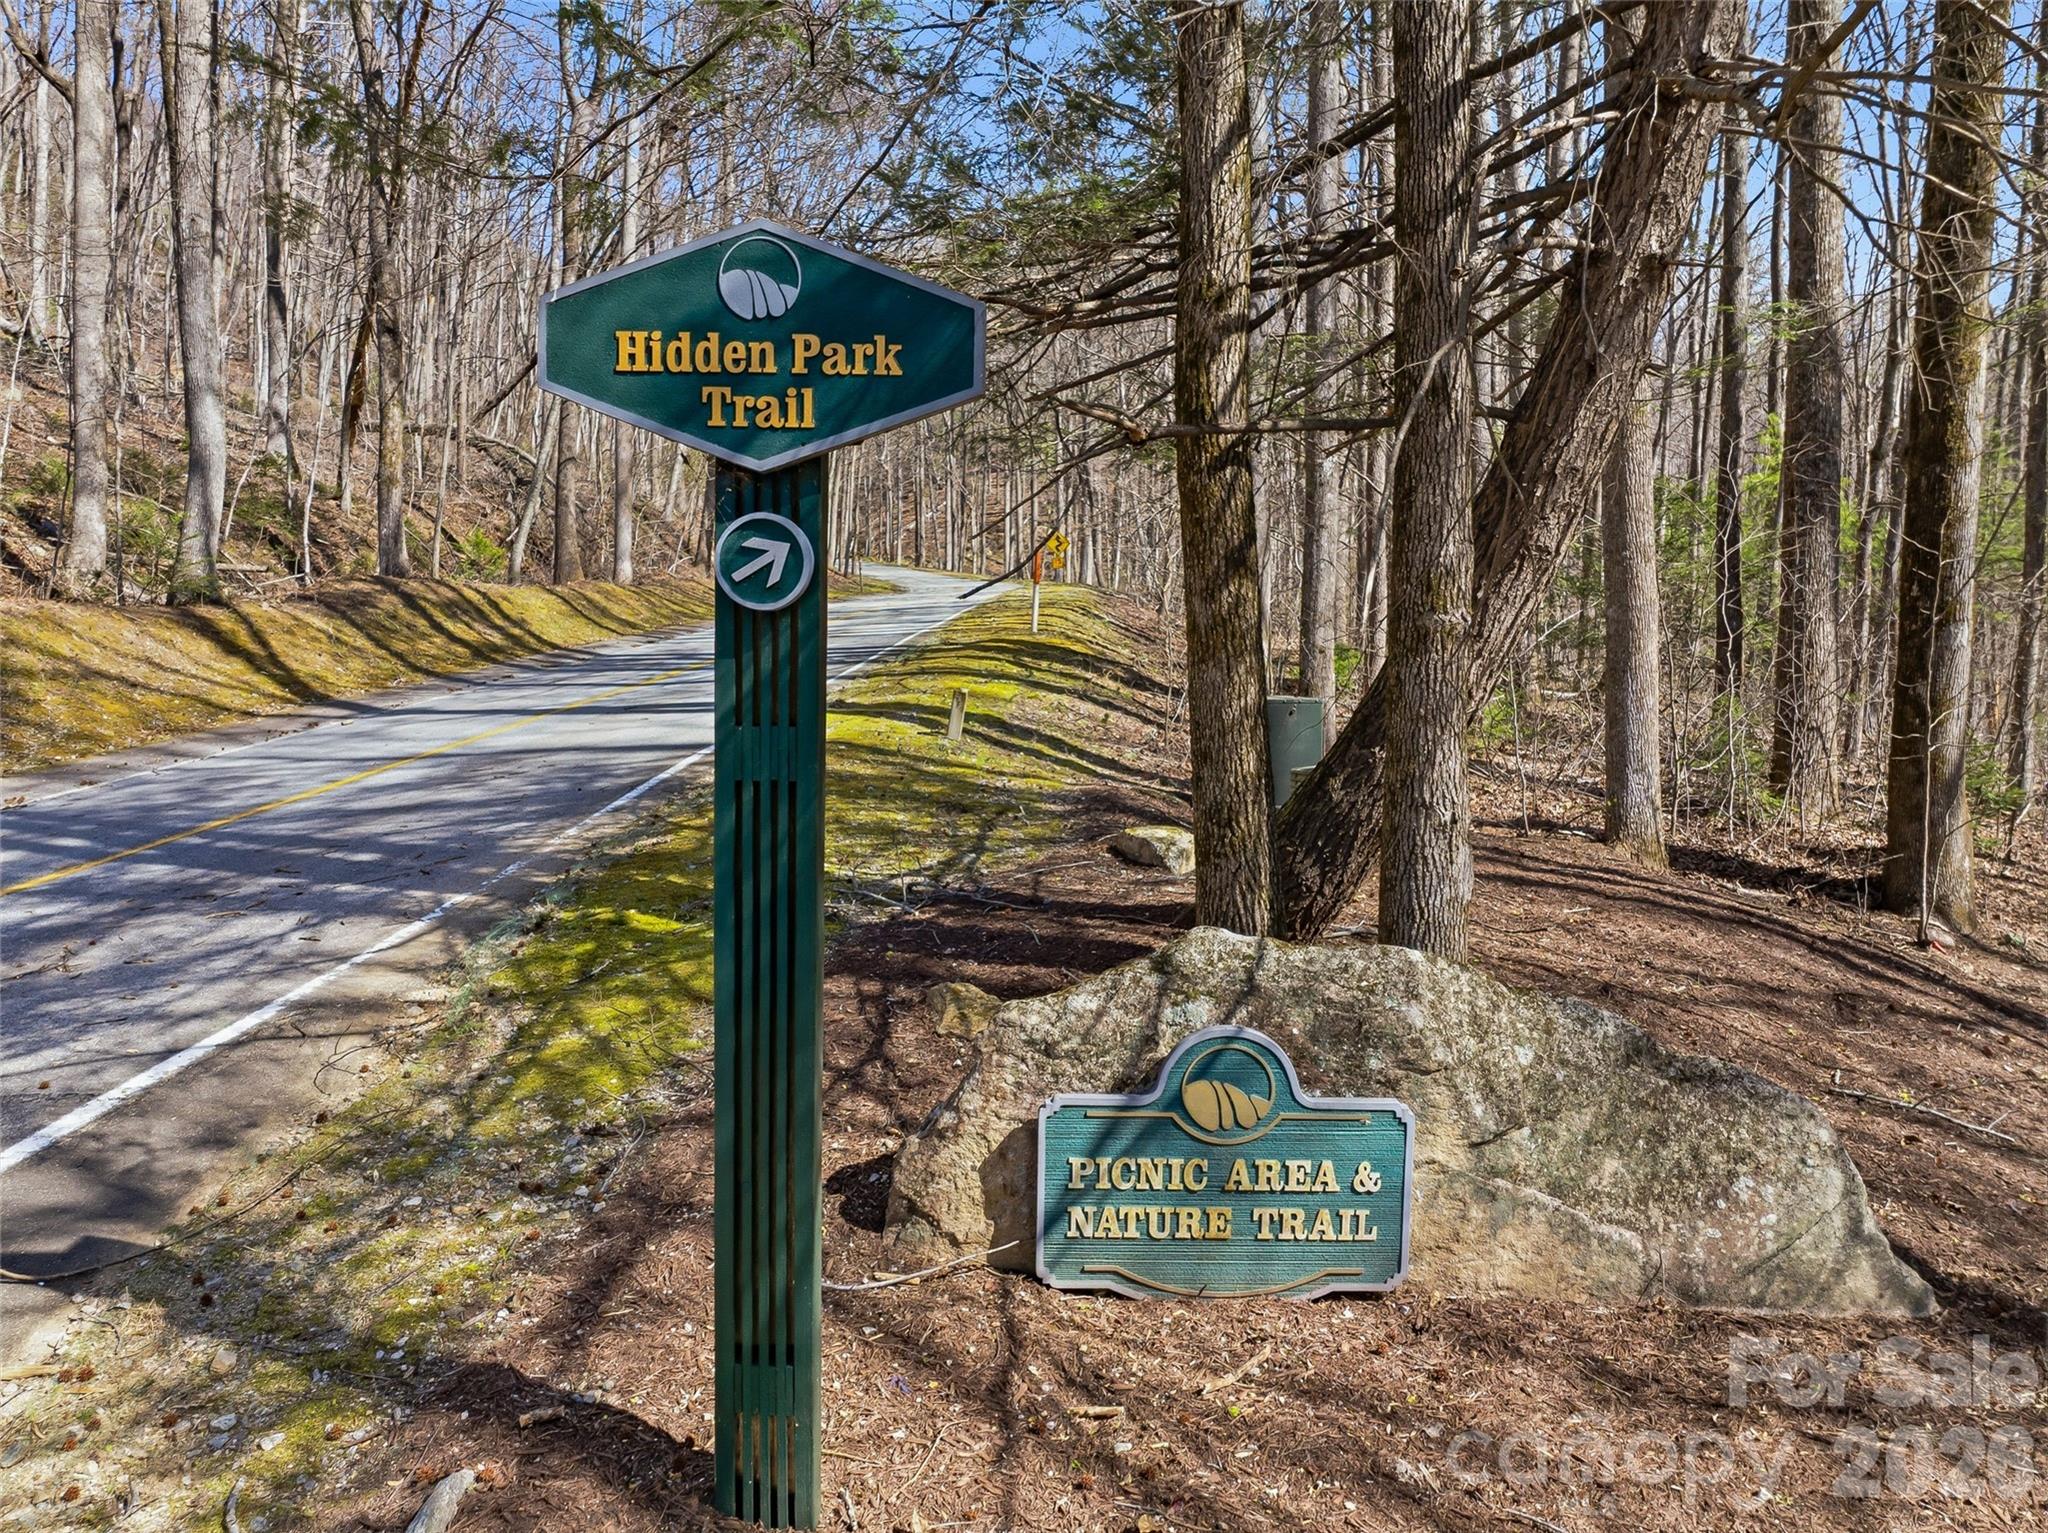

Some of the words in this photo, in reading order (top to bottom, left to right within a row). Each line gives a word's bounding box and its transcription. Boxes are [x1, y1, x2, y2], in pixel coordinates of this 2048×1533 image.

[614, 330, 778, 374] Hidden
[791, 333, 903, 376] Park
[702, 386, 815, 428] Trail
[1067, 1157, 1208, 1191] PICNIC
[1224, 1159, 1340, 1192] AREA
[1352, 1161, 1382, 1193] &
[1066, 1206, 1232, 1240] NATURE
[1252, 1208, 1378, 1241] TRAIL
